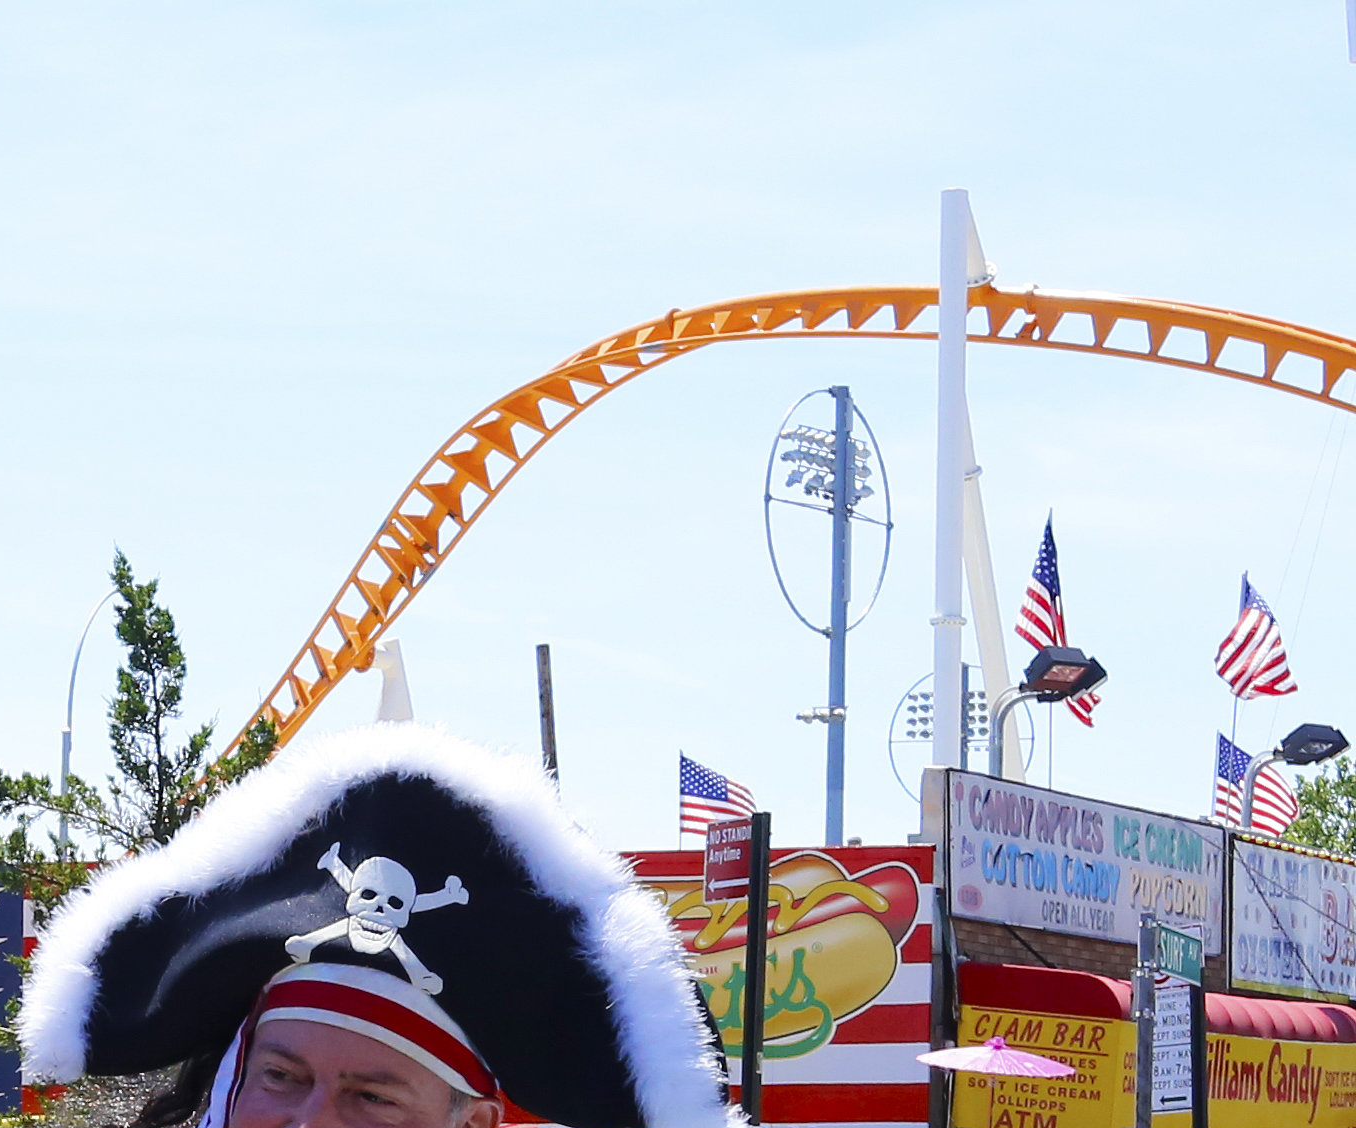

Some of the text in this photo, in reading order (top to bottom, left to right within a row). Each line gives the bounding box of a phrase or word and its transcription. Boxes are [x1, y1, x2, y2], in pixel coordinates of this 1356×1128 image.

[709, 824, 752, 845] NO STANDI
[969, 785, 1034, 840] CANDY
[1035, 799, 1104, 855] APPLES
[1113, 814, 1141, 862] ICE
[1145, 822, 1203, 875] CREAM
[709, 846, 742, 865] Anytime
[981, 838, 1058, 895] COTTON
[1061, 854, 1121, 905] CANDY
[1129, 866, 1208, 921] POPCORN
[1042, 899, 1115, 933] OPEN ALL YEAR
[1160, 931, 1185, 973] SURF
[1158, 1001, 1177, 1011] JUNE
[975, 1014, 1106, 1051] CLAM BAR
[1152, 1030, 1191, 1042] CEPT SUND
[967, 1077, 1102, 1101] SOT ICE CREAM
[1153, 1079, 1192, 1091] CEPT SUND
[1207, 1039, 1322, 1125] illiams Candy
[993, 1095, 1067, 1113] OLLIPOPS
